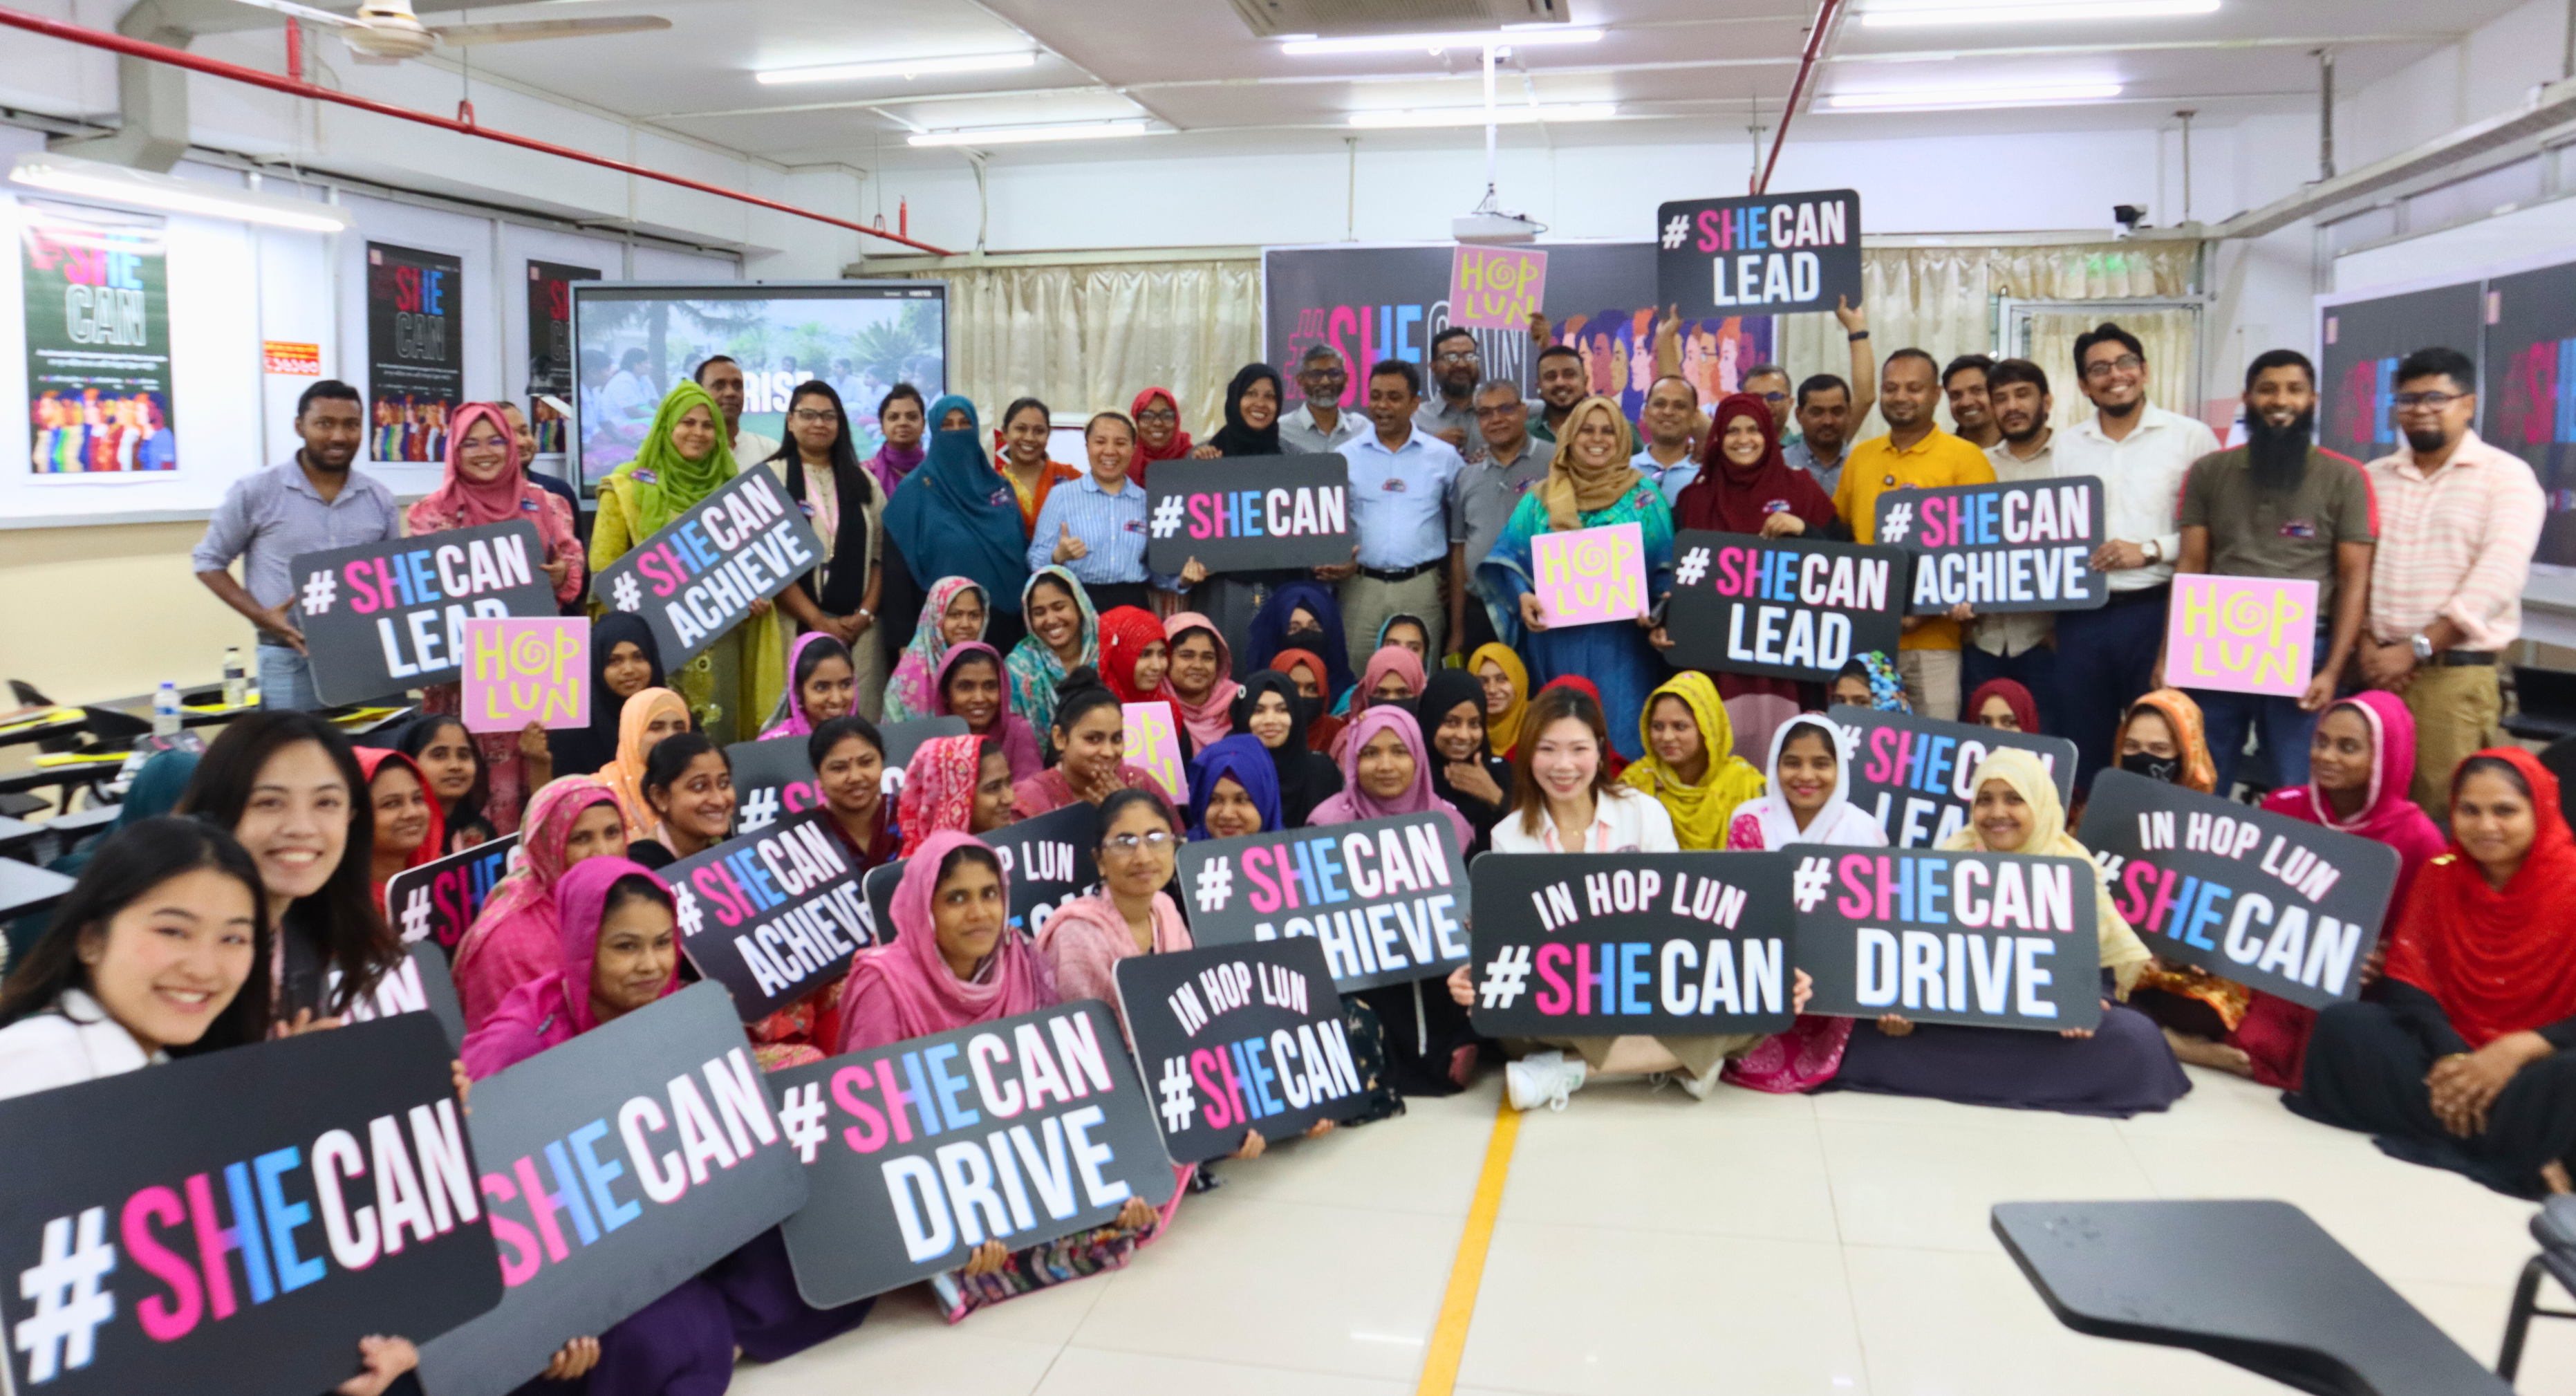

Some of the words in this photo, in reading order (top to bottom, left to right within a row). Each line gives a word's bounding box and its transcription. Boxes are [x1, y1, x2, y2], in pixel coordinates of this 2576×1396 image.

[1460, 251, 1539, 299] HOP
[1713, 252, 1820, 307] LEAD
[65, 283, 147, 346] CAN
[395, 311, 446, 361] CAN
[1464, 292, 1536, 325] LUN
[664, 519, 814, 649] ACHIEVE
[1542, 532, 1635, 586] HOP
[1912, 545, 2089, 606] ACHIEVE
[1556, 575, 1638, 617] LUN
[2183, 581, 2304, 650] HOP
[474, 624, 581, 682] HOP
[1727, 602, 1853, 671] LEAD
[2191, 640, 2301, 687] LUN
[487, 676, 579, 722] LUN
[1022, 840, 1074, 883] LUN
[2138, 810, 2176, 852] IN
[2185, 812, 2261, 862] HOP
[2259, 833, 2340, 903] LUN
[1531, 881, 1580, 931] IN
[1584, 868, 1662, 917] HOP
[1670, 872, 1747, 931] LUN
[734, 879, 877, 998] ACHIEVE
[1253, 893, 1468, 979] HIEVE
[1168, 980, 1208, 1038] IN
[1197, 963, 1254, 1017] HOP
[1259, 960, 1309, 1016] LUN
[1856, 927, 2059, 1019] DRIVE
[880, 1104, 1133, 1265] DRIVE
